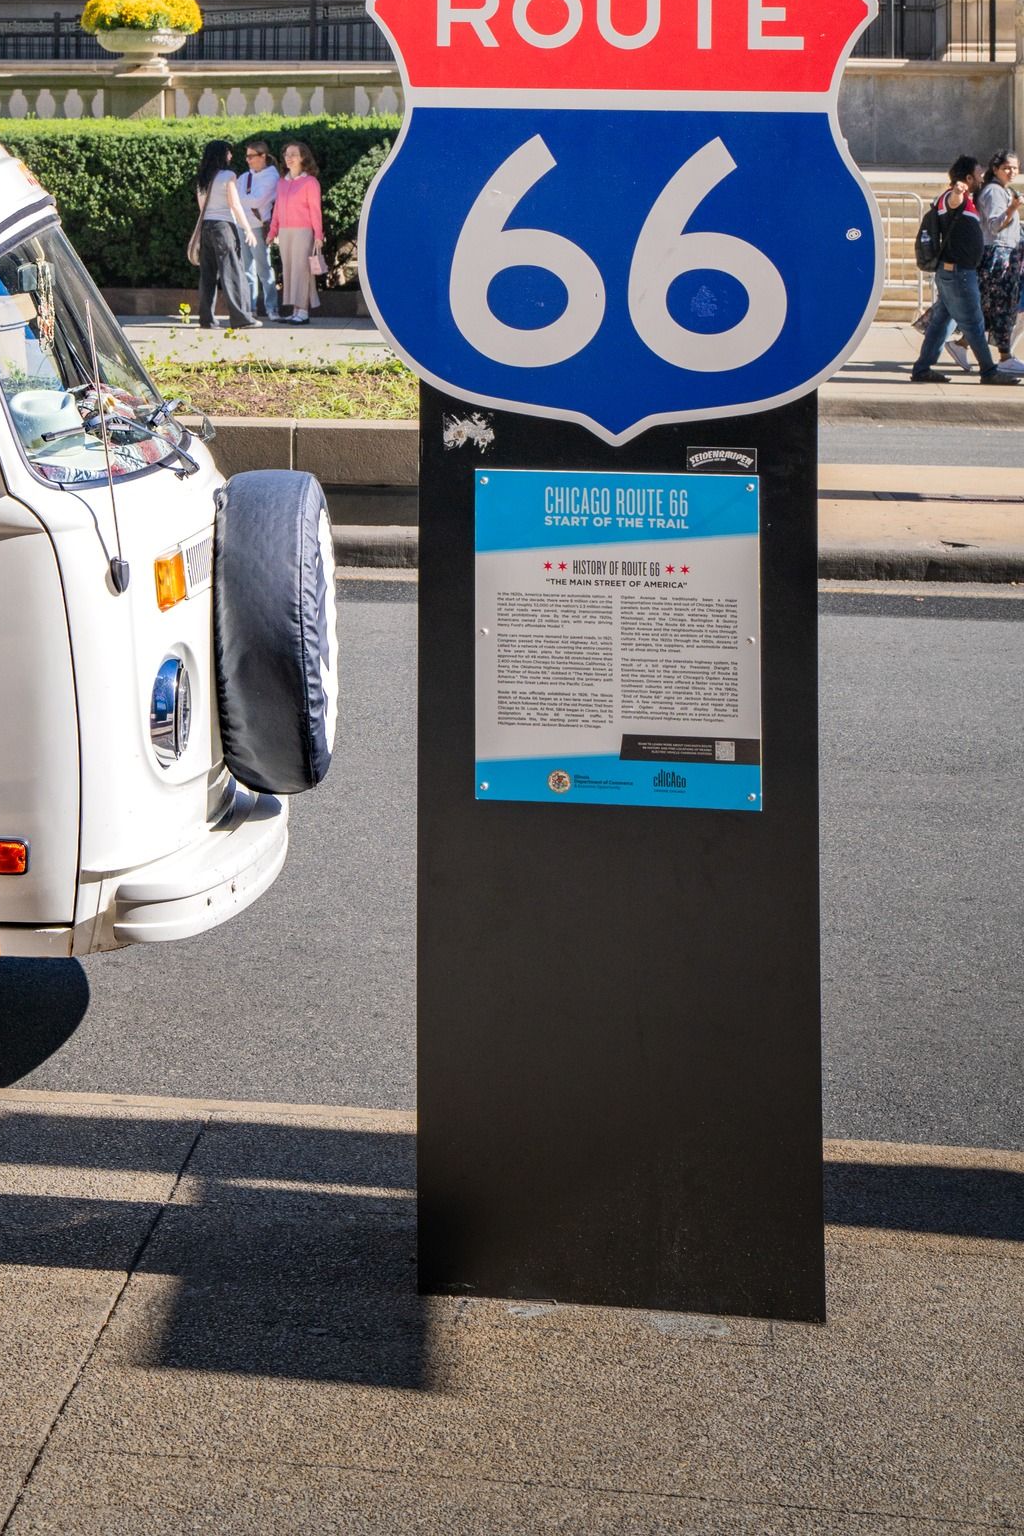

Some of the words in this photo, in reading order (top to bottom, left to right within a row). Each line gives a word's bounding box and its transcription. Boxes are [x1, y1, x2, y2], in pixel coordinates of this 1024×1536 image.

[448, 133, 788, 373] 66
[544, 486, 611, 515] CHICAGO
[616, 488, 664, 517] ROUTE
[669, 489, 689, 517] 66
[544, 516, 589, 527] START
[593, 516, 612, 527] OF
[616, 517, 643, 528] THE
[648, 518, 689, 529] TRAIL
[572, 559, 607, 575] HISTORY
[609, 560, 619, 576] OF
[621, 561, 647, 576] ROUTE
[649, 561, 660, 577] 66
[594, 579, 626, 587] STREET
